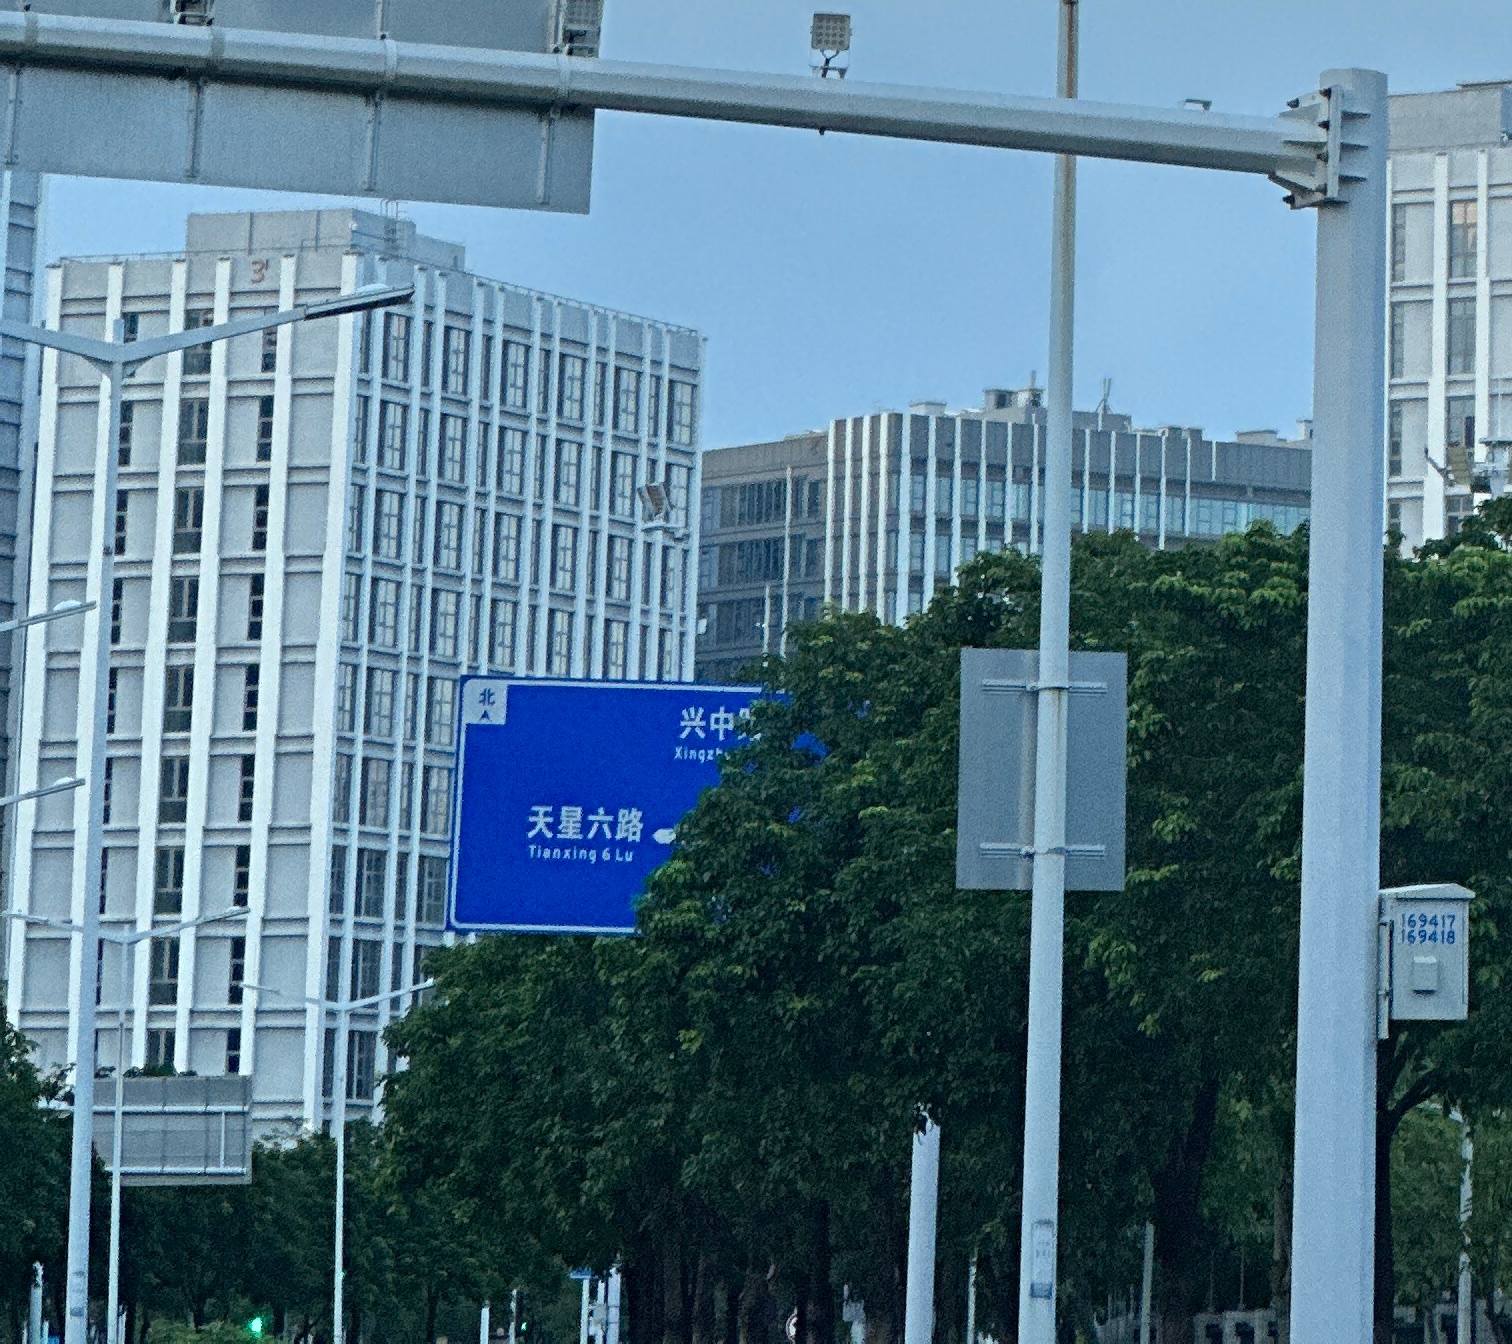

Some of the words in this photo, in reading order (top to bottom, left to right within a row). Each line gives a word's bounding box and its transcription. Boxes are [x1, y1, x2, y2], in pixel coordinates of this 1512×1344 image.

[478, 687, 496, 706] 北
[527, 805, 644, 843] 天星六路
[528, 844, 597, 864] Tianxing
[602, 847, 611, 861] 6
[615, 848, 634, 862] Lu
[1401, 913, 1456, 929] 169417
[1401, 929, 1456, 945] 169418
